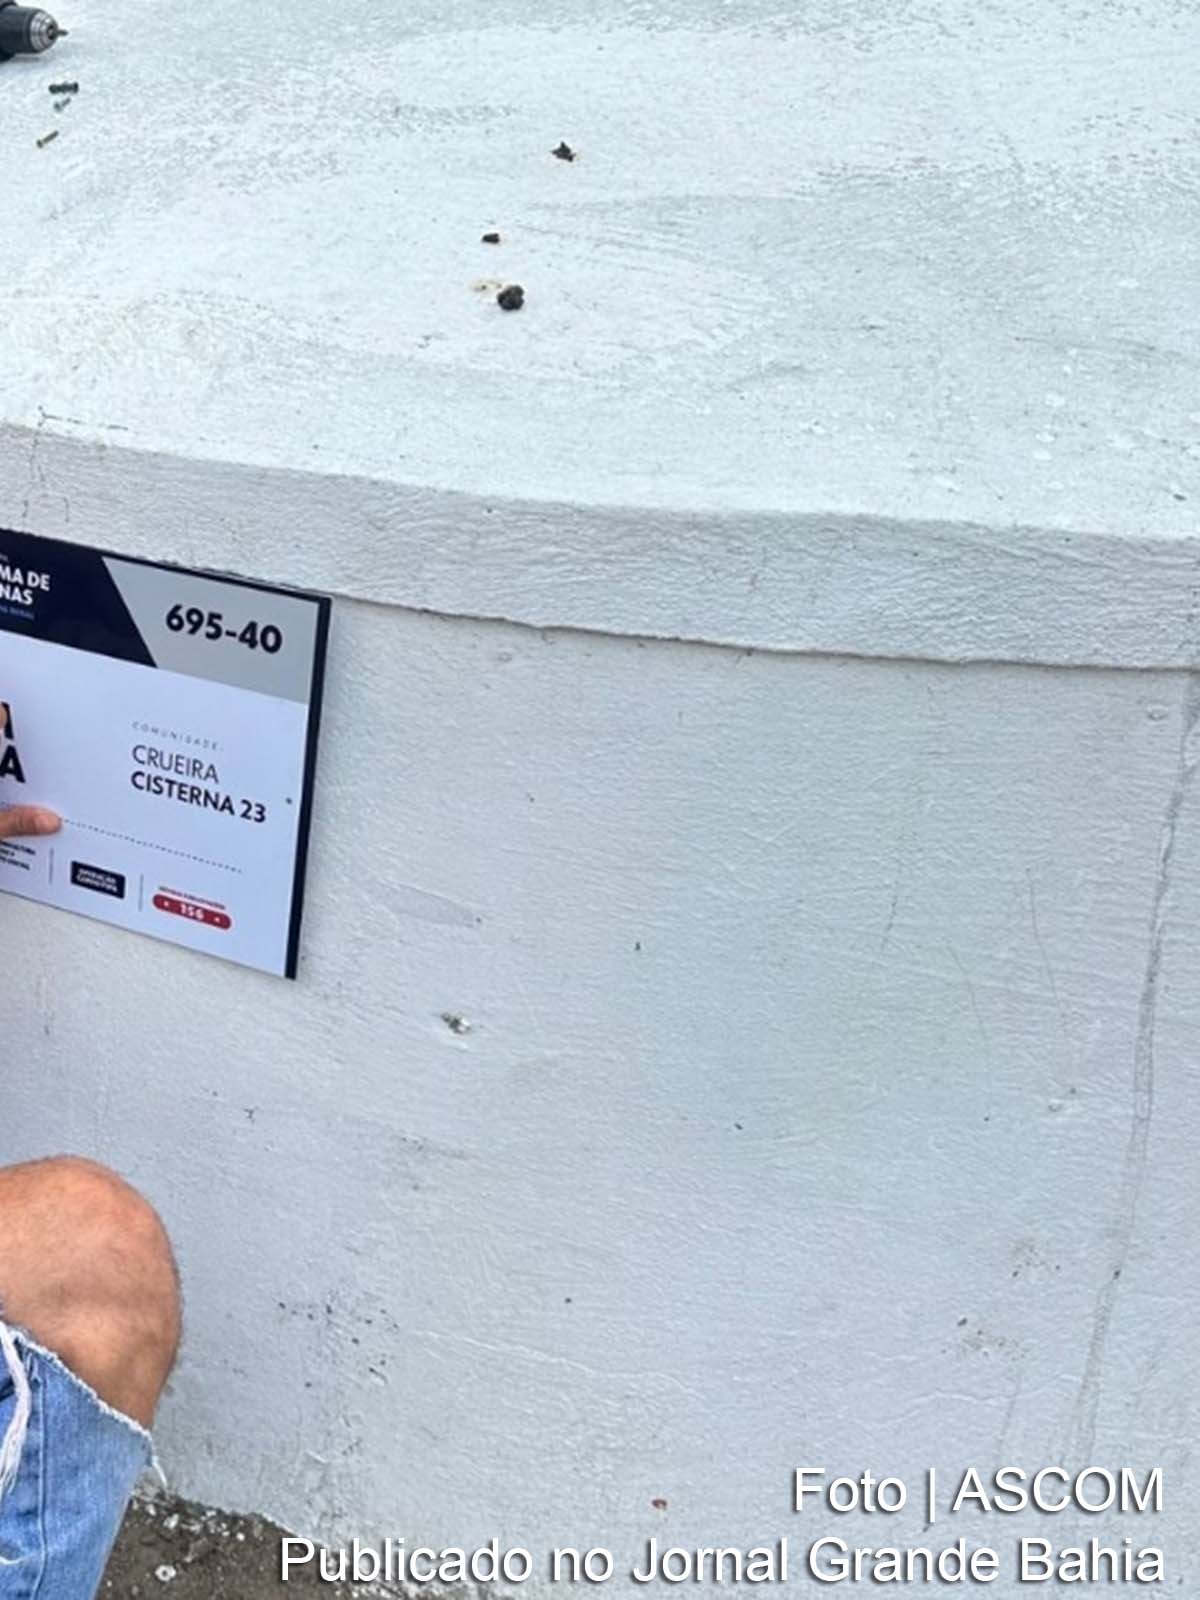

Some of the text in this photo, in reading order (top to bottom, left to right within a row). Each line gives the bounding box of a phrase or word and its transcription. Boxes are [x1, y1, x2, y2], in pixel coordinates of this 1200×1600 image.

[26, 570, 51, 591] DE
[165, 603, 284, 655] 695-40
[131, 744, 220, 785] CRUEIRA
[130, 770, 267, 824] CISTERNA 23
